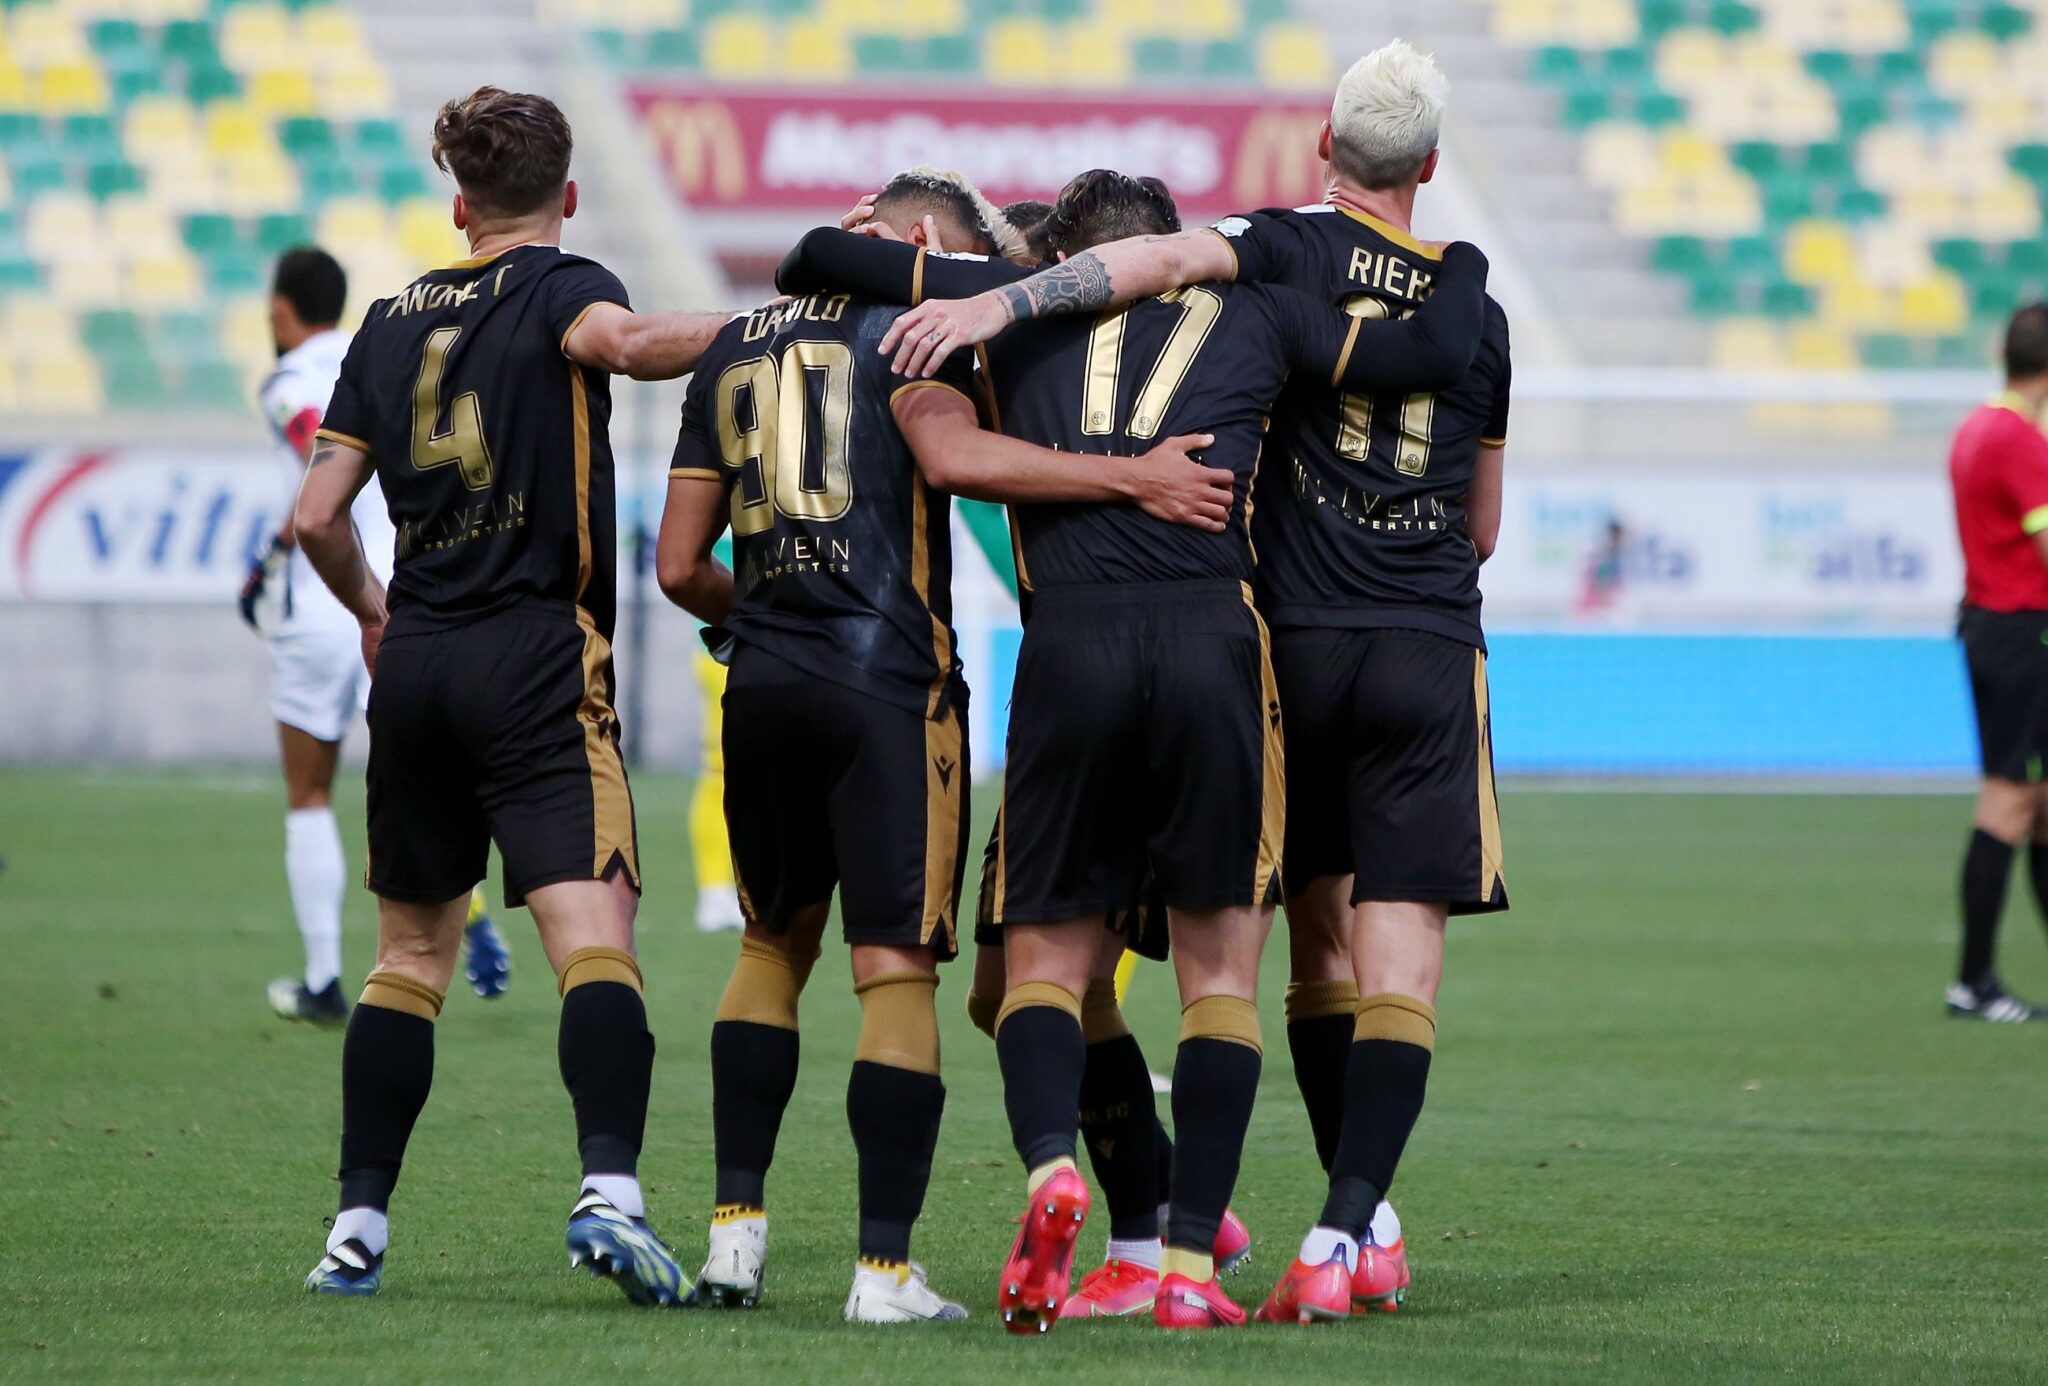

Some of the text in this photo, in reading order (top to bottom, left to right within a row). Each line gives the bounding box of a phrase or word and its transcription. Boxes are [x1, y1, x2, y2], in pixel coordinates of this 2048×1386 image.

[763, 112, 1223, 195] McDonald's
[1347, 246, 1435, 302] RIER
[742, 293, 852, 343] DANILO
[1081, 285, 1223, 440] 17
[410, 326, 494, 492] 4
[715, 338, 856, 537] 90
[1317, 479, 1448, 519] IVEIN
